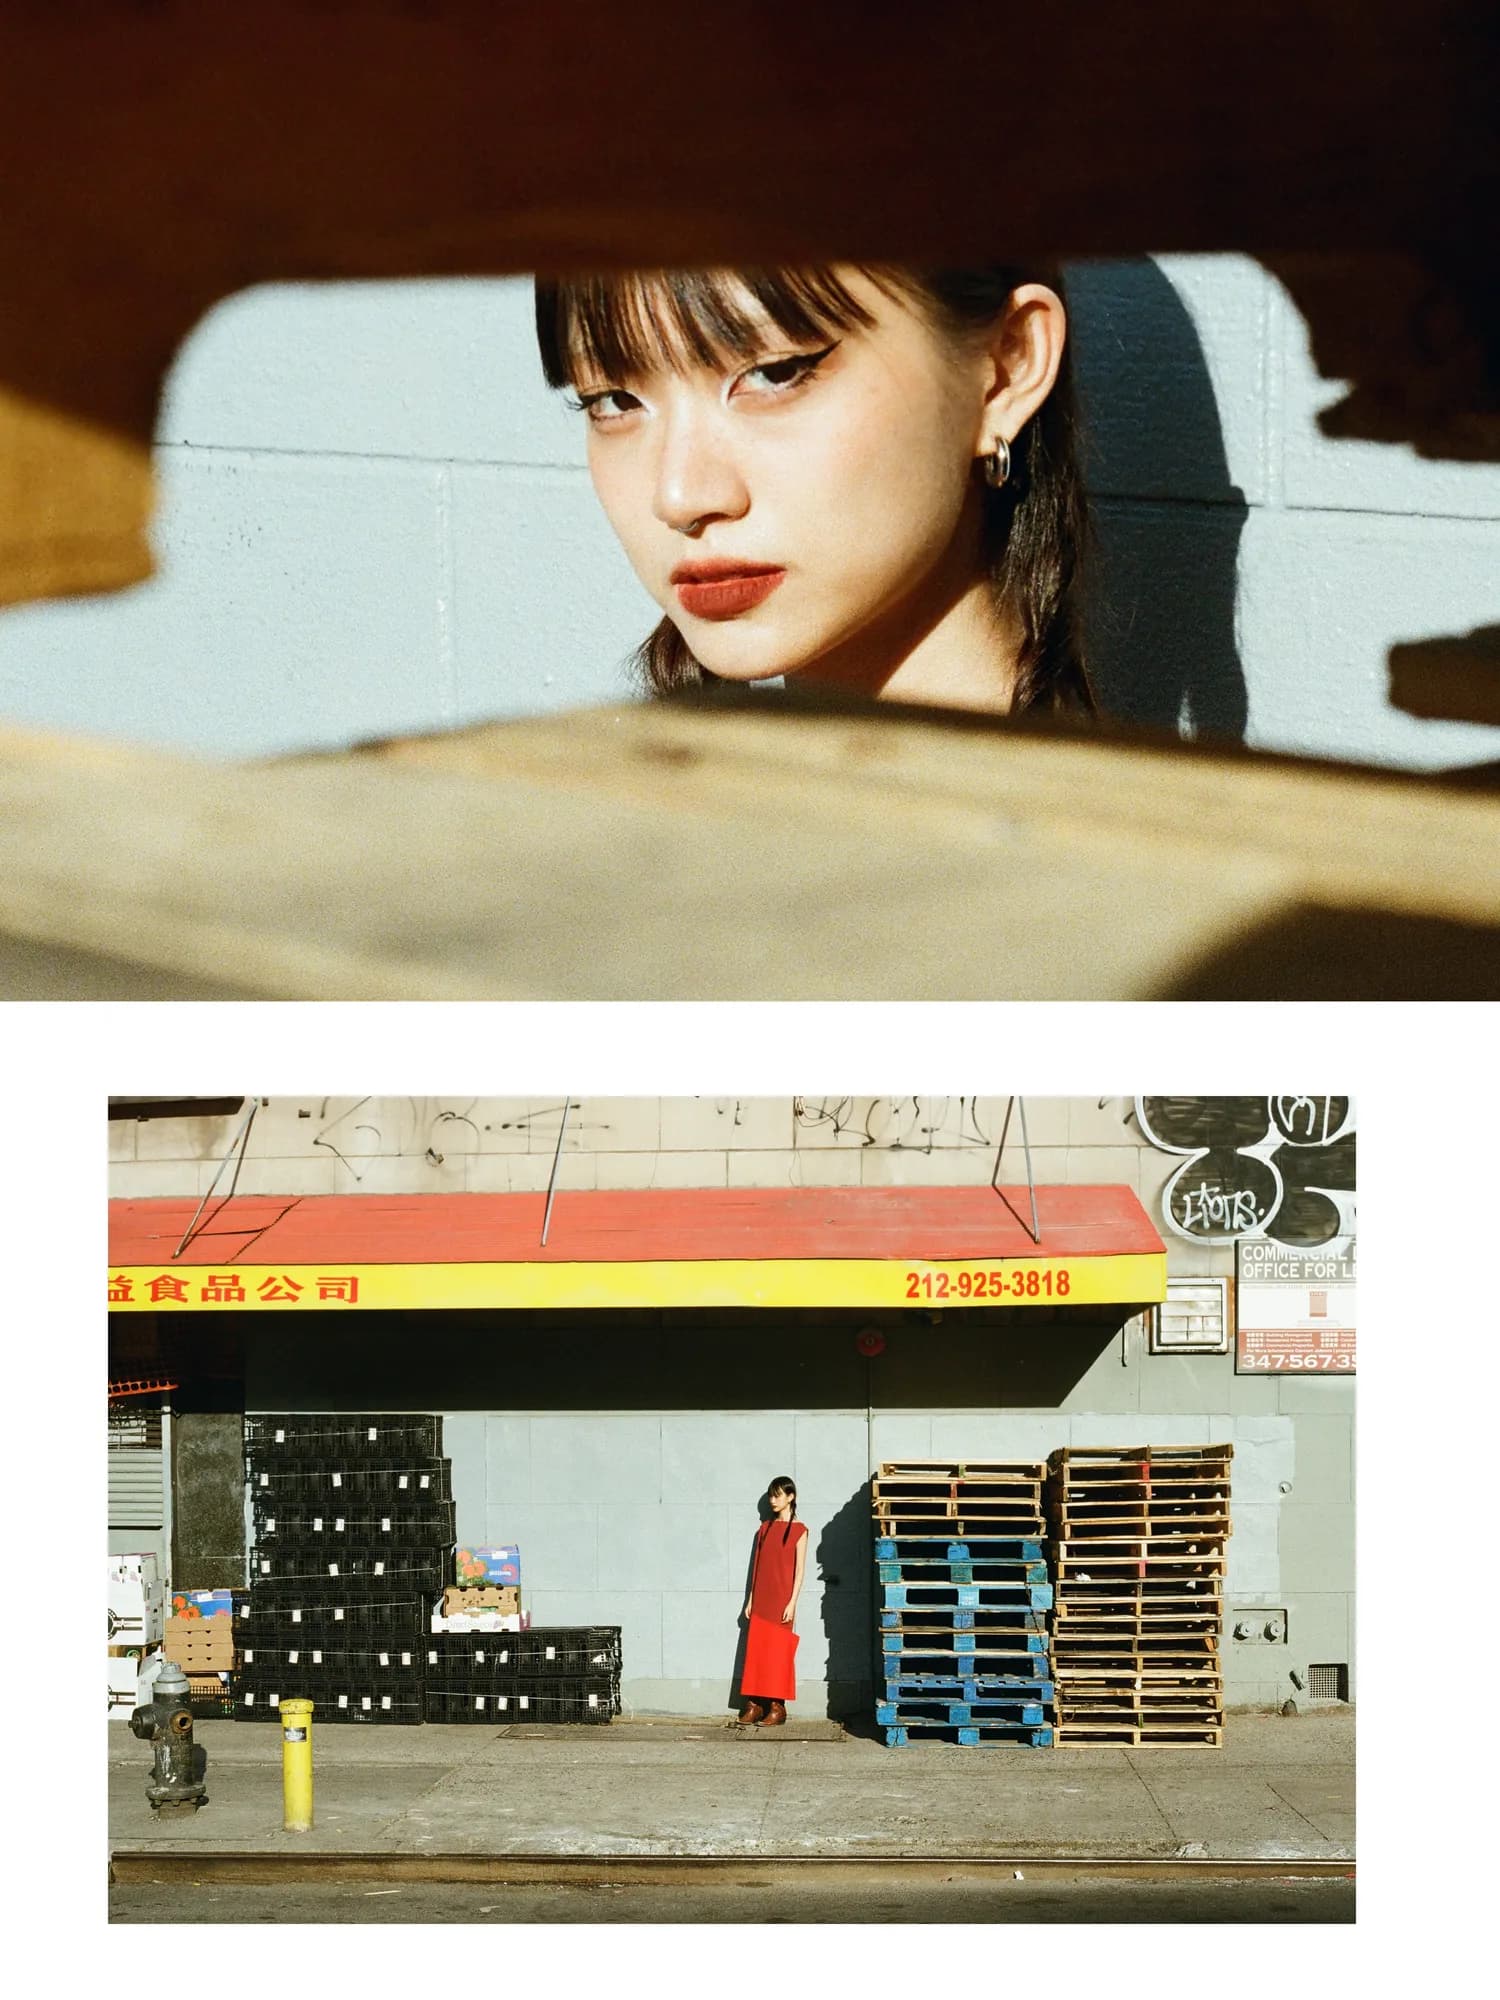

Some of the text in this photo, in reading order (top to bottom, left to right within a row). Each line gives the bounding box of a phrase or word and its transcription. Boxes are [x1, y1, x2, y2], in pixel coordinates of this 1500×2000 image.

[1243, 1262, 1357, 1278] OFFICE FOR L
[906, 1270, 1070, 1298] 212-925-3818
